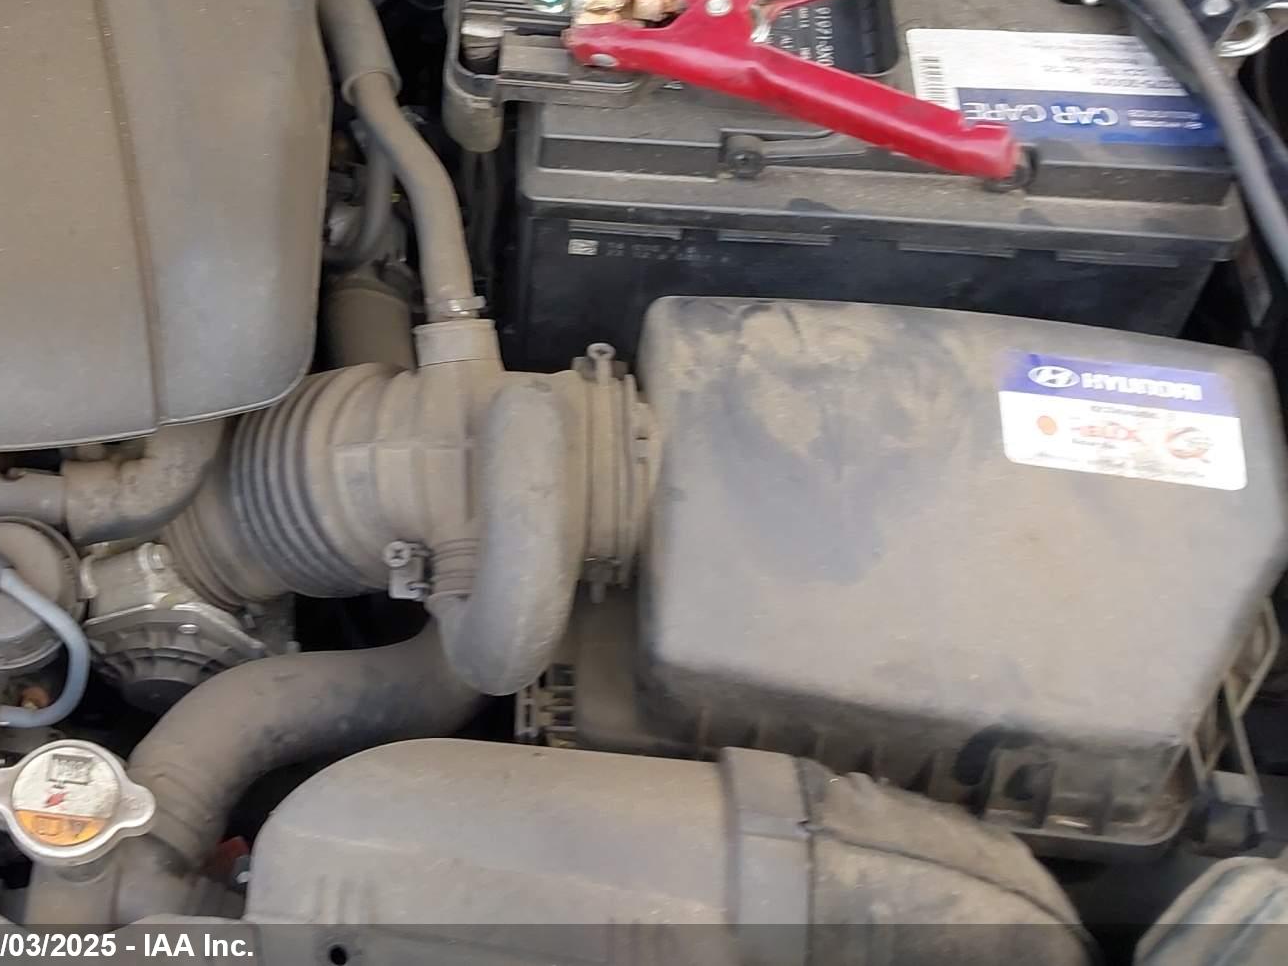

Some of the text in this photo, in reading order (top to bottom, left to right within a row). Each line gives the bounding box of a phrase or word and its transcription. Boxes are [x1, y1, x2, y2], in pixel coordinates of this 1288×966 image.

[962, 101, 1048, 123] CARE
[1051, 105, 1119, 126] CAR
[1079, 371, 1203, 402] HYUNDAI
